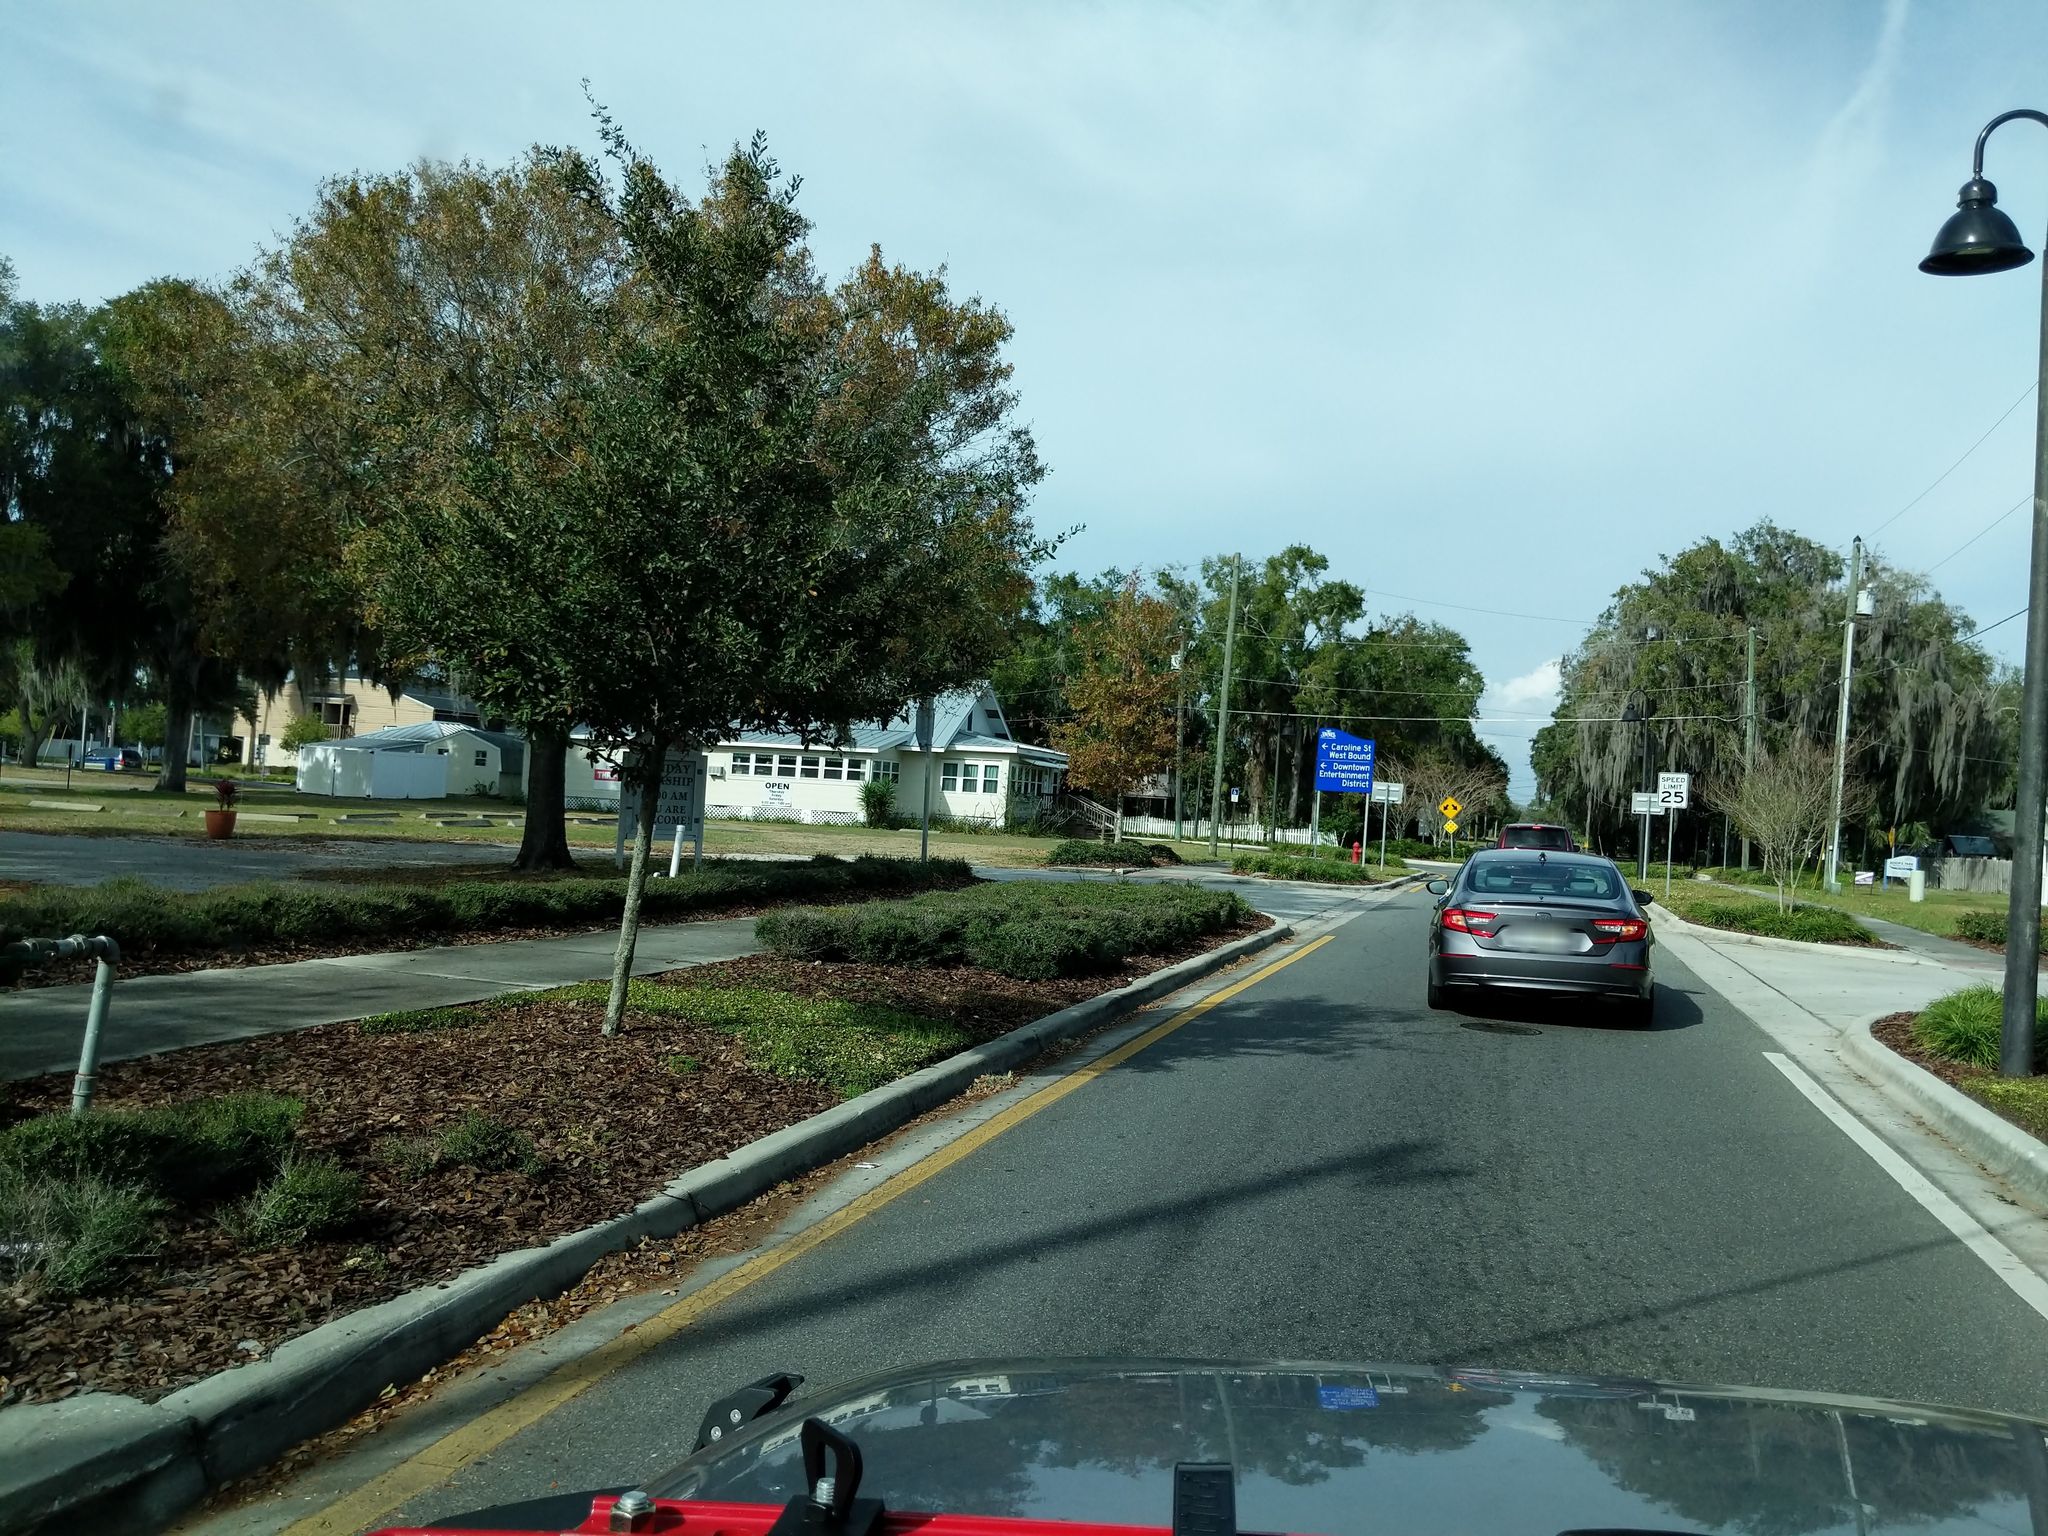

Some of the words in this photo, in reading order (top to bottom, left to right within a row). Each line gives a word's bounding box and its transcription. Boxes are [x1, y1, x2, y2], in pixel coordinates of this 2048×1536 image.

[1331, 743, 1361, 752] Caroline
[1363, 744, 1371, 752] St
[1348, 752, 1371, 760] Bound
[1333, 762, 1370, 771] Downtown
[1319, 771, 1369, 780] Entertainment
[765, 782, 790, 790] OPEN
[1341, 779, 1369, 788] District
[671, 791, 688, 801] AM
[1660, 791, 1684, 804] 25
[665, 805, 686, 814] ARE
